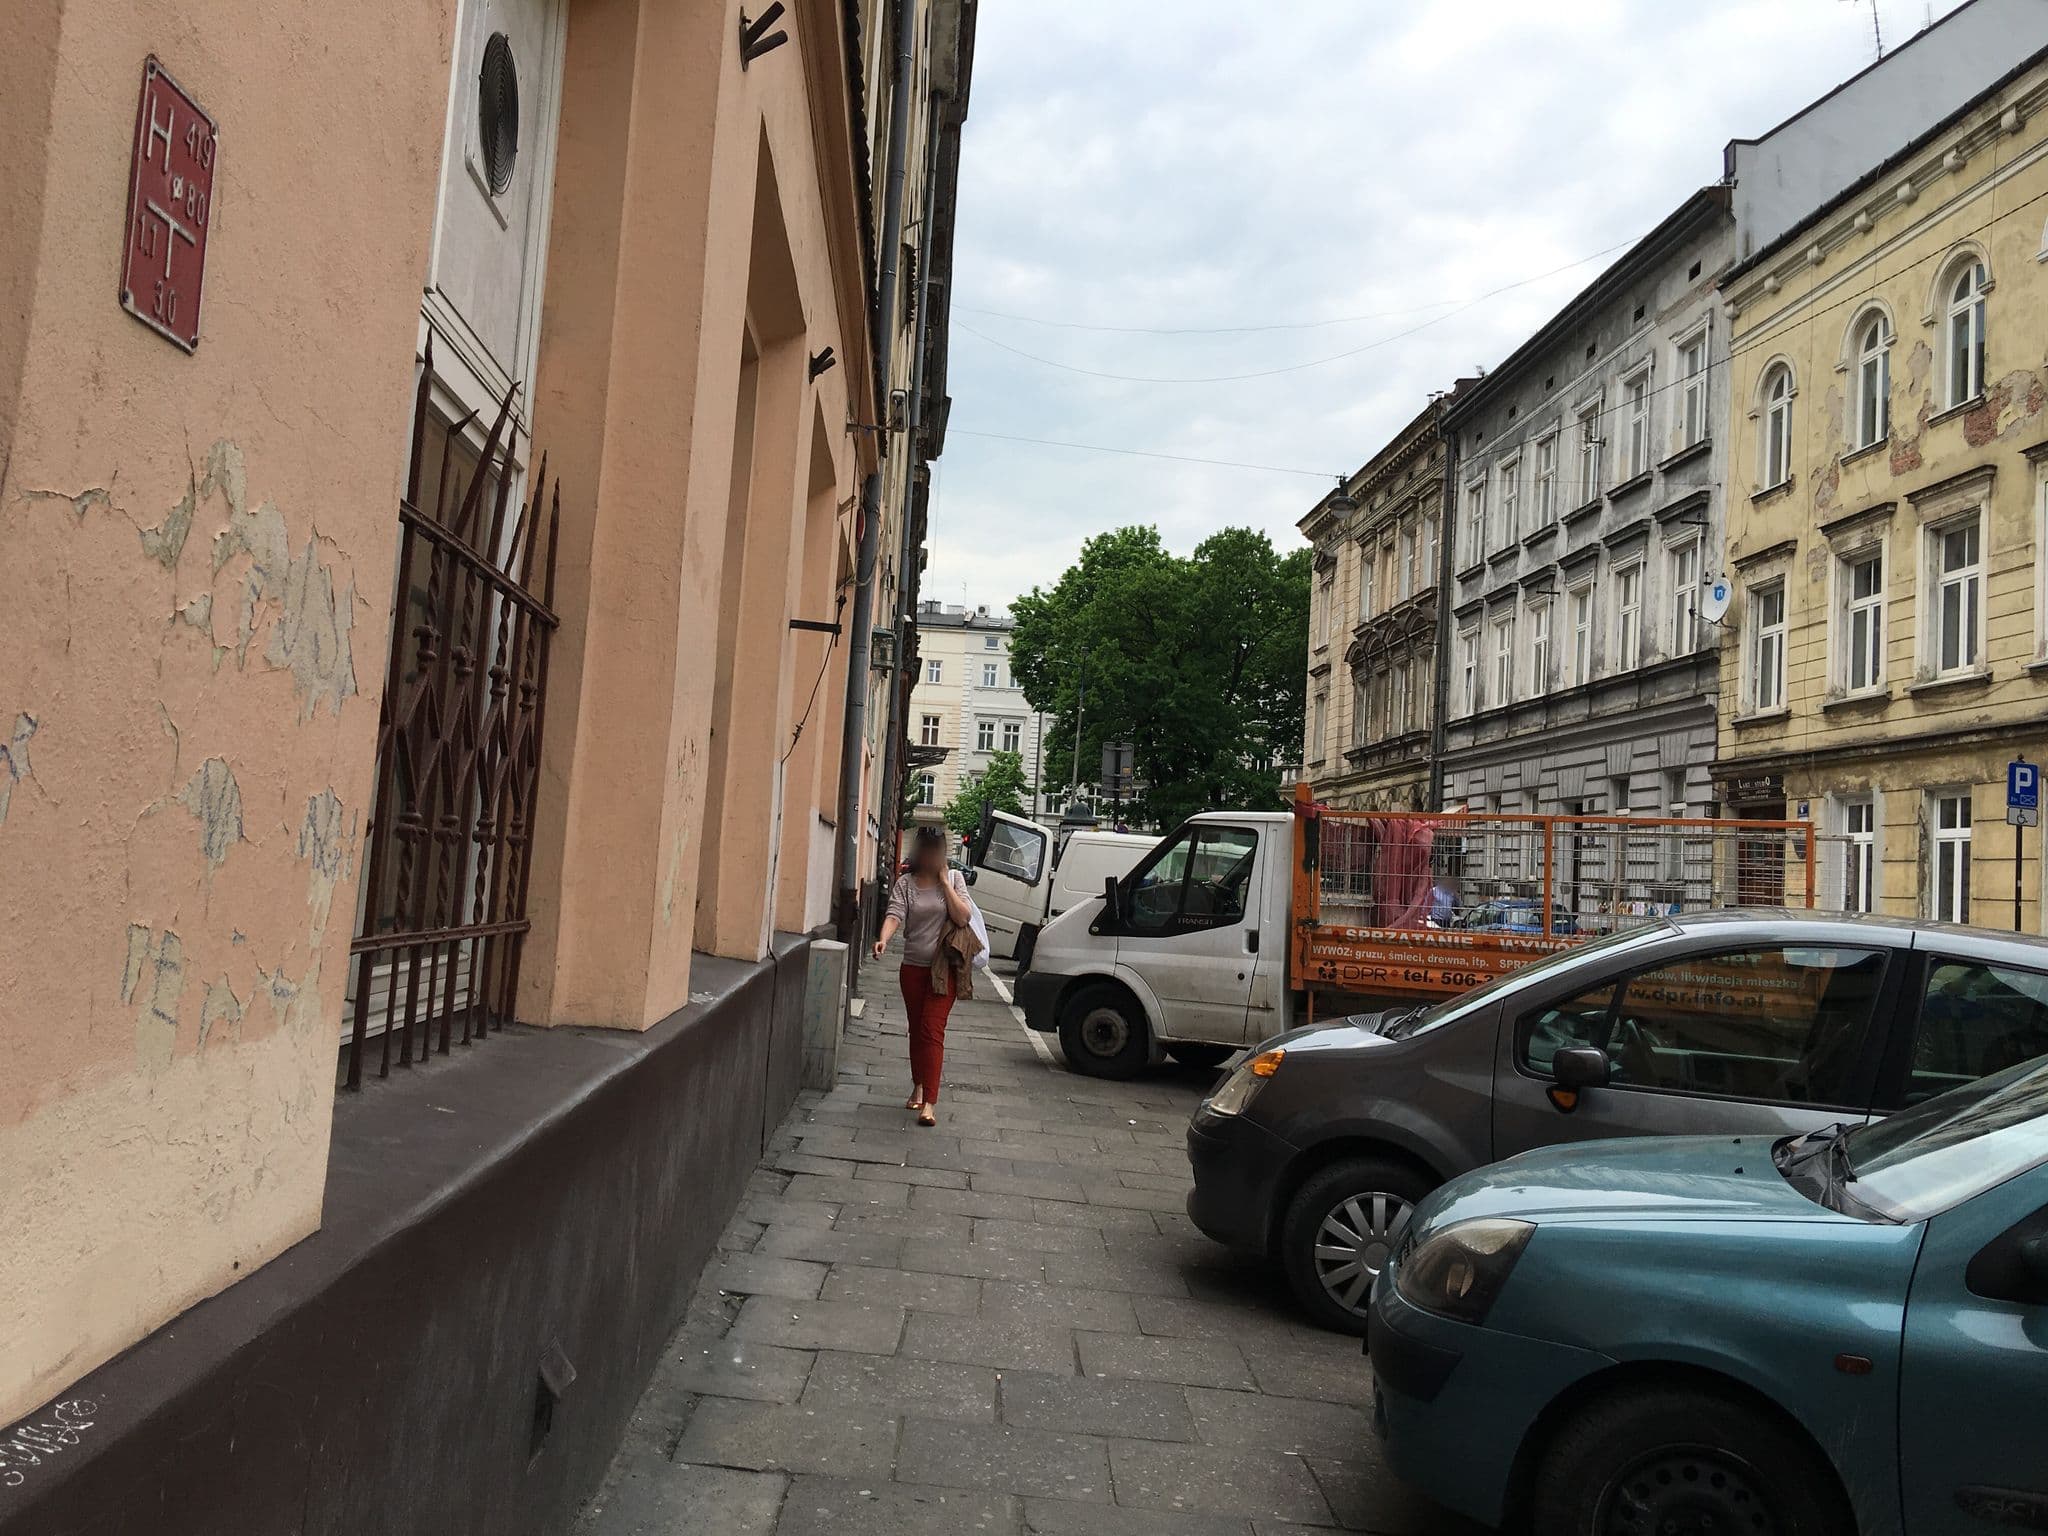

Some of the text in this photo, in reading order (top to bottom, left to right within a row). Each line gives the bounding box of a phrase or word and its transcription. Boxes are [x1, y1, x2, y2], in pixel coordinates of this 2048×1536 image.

[146, 91, 213, 174] H 419
[2015, 766, 2032, 794] P
[1345, 928, 1474, 950] SPRZĄTANIE
[1312, 944, 1352, 957] WYWÓZ:
[1355, 949, 1386, 961] gruzu,
[1388, 951, 1425, 964] śmieci,
[1427, 953, 1469, 966] drewna,
[1472, 956, 1489, 968] itp.
[1499, 959, 1535, 970] SPRZ
[1680, 971, 1744, 987] likwidacja
[1343, 965, 1388, 982] DPR
[1404, 969, 1434, 984] tel.
